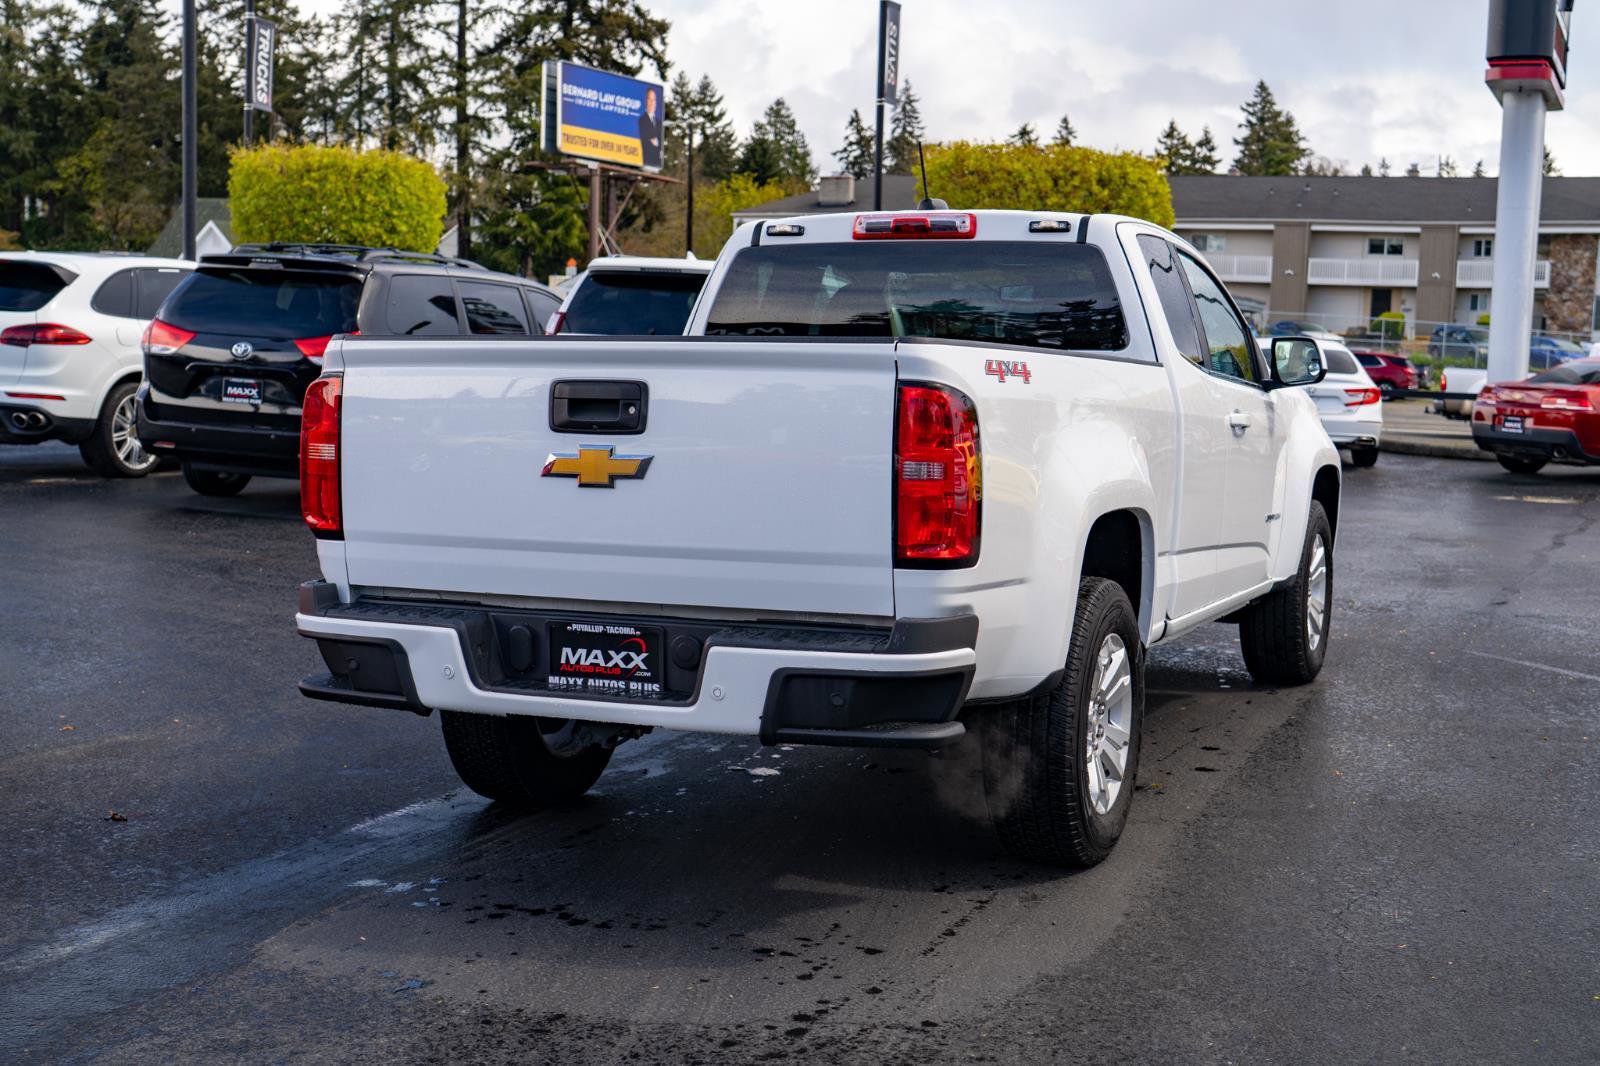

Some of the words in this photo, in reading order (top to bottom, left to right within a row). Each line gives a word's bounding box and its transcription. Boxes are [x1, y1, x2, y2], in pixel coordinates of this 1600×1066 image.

[257, 28, 271, 104] TRUCKS
[562, 83, 598, 100] BERNARD
[599, 91, 615, 103] LAW
[615, 95, 641, 110] GROUP
[575, 98, 599, 108] INJURY
[601, 103, 629, 115] LAWYERS
[227, 386, 258, 397] MAXX
[561, 647, 649, 670] MAXX
[560, 664, 594, 673] AUTOS
[596, 667, 621, 675] PLUS
[548, 676, 583, 686] MAXX
